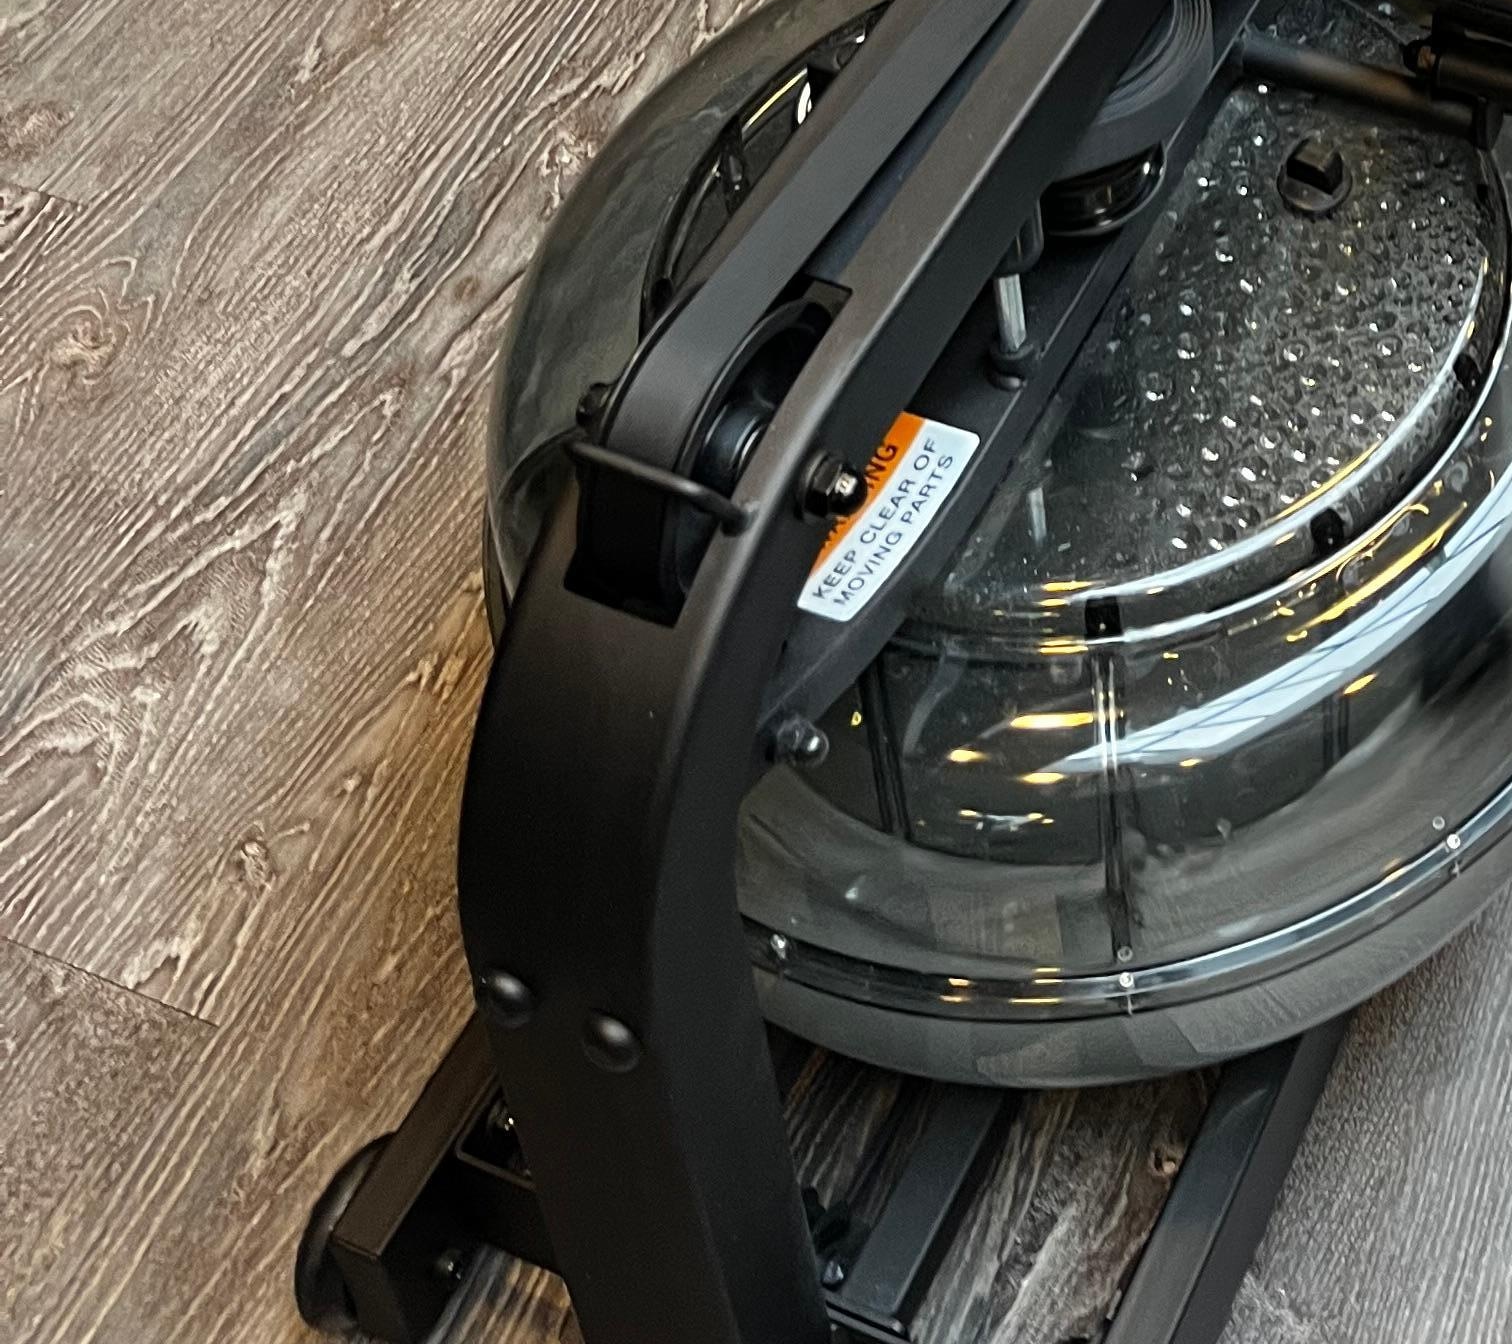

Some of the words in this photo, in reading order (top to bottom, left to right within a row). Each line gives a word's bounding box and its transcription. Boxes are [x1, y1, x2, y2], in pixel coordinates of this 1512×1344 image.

[812, 550, 857, 599] KEEP
[860, 479, 916, 546] CLEAR
[913, 438, 937, 471] OF
[833, 531, 902, 605] MOVING
[900, 454, 953, 525] PARTS
